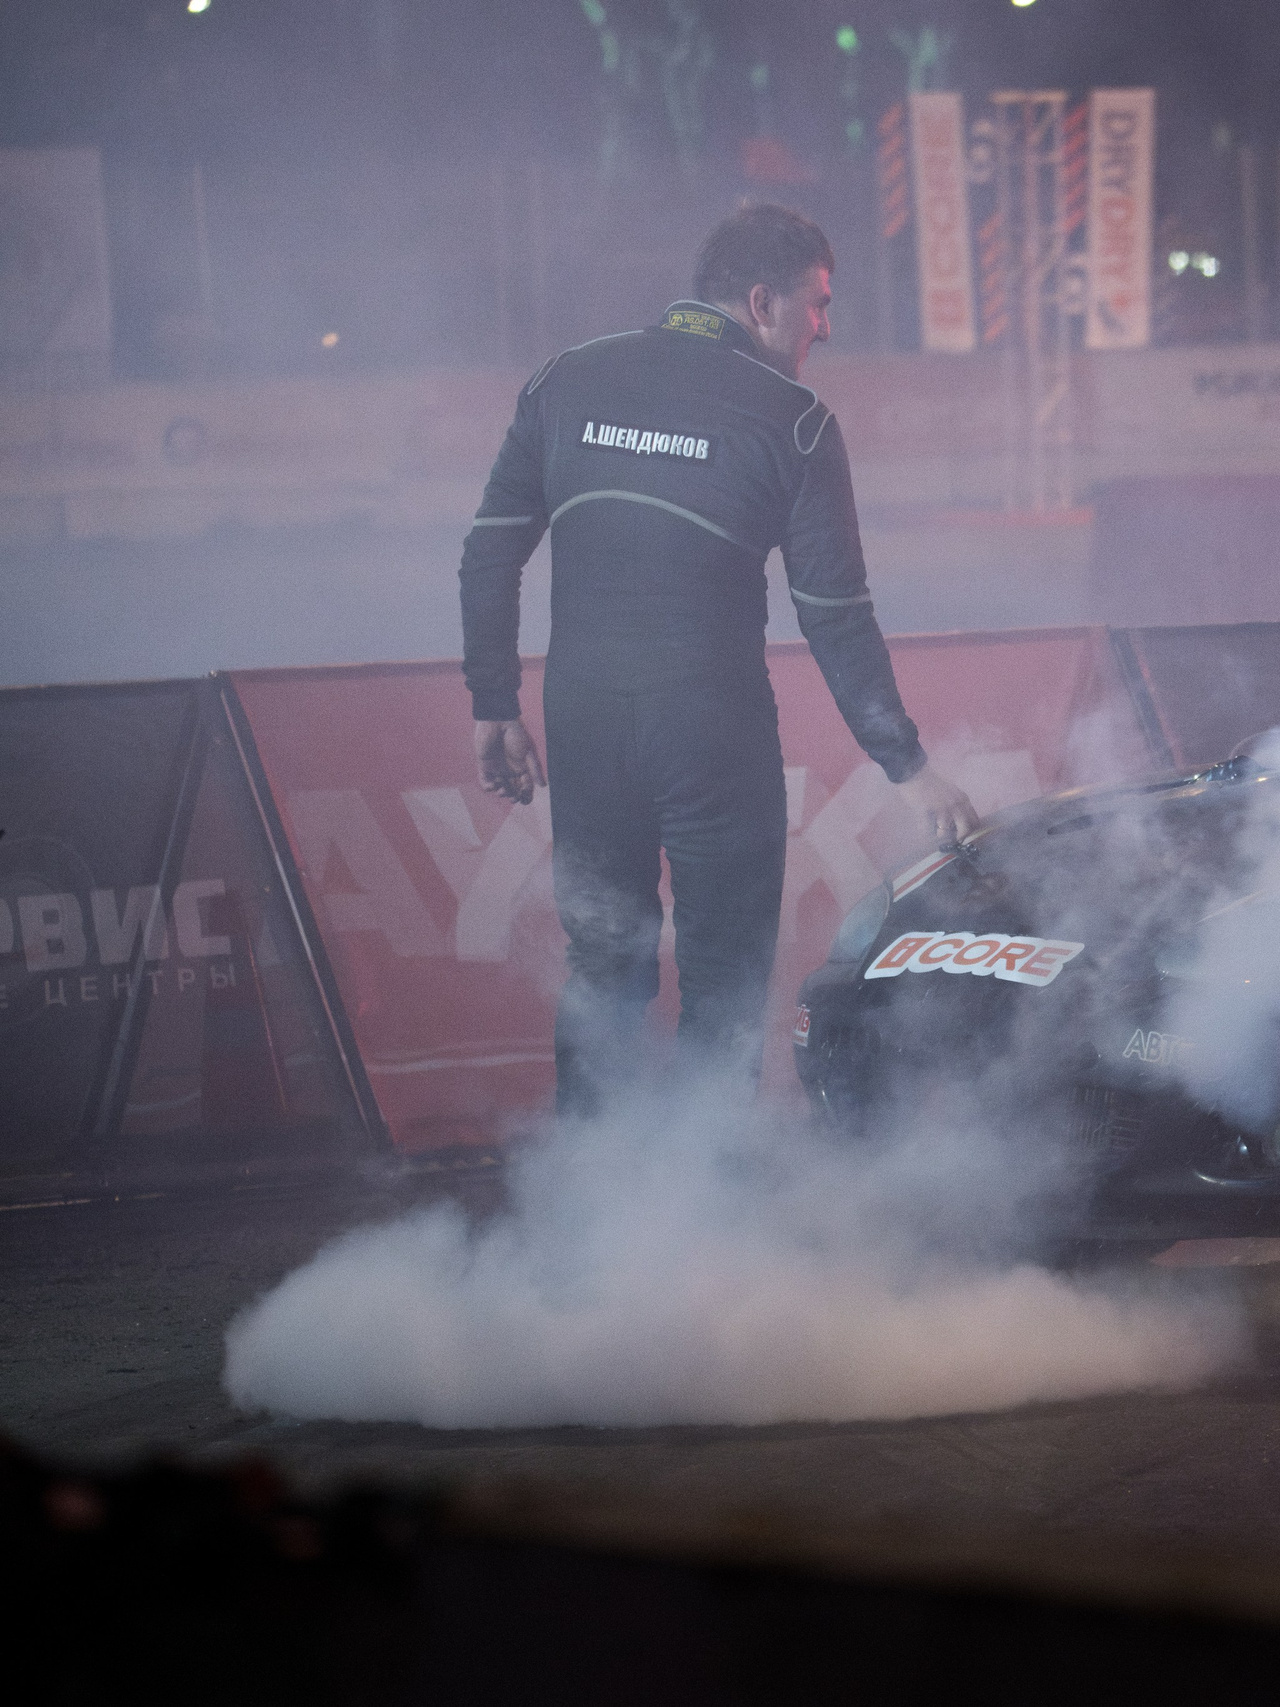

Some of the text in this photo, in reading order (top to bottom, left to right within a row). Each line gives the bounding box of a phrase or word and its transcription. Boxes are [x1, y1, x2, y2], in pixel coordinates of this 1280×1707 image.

[582, 421, 710, 460] А.ШЕНДЮКОВ
[0, 878, 233, 973] ВИС
[43, 962, 238, 1008] ЦЕНТРЫ
